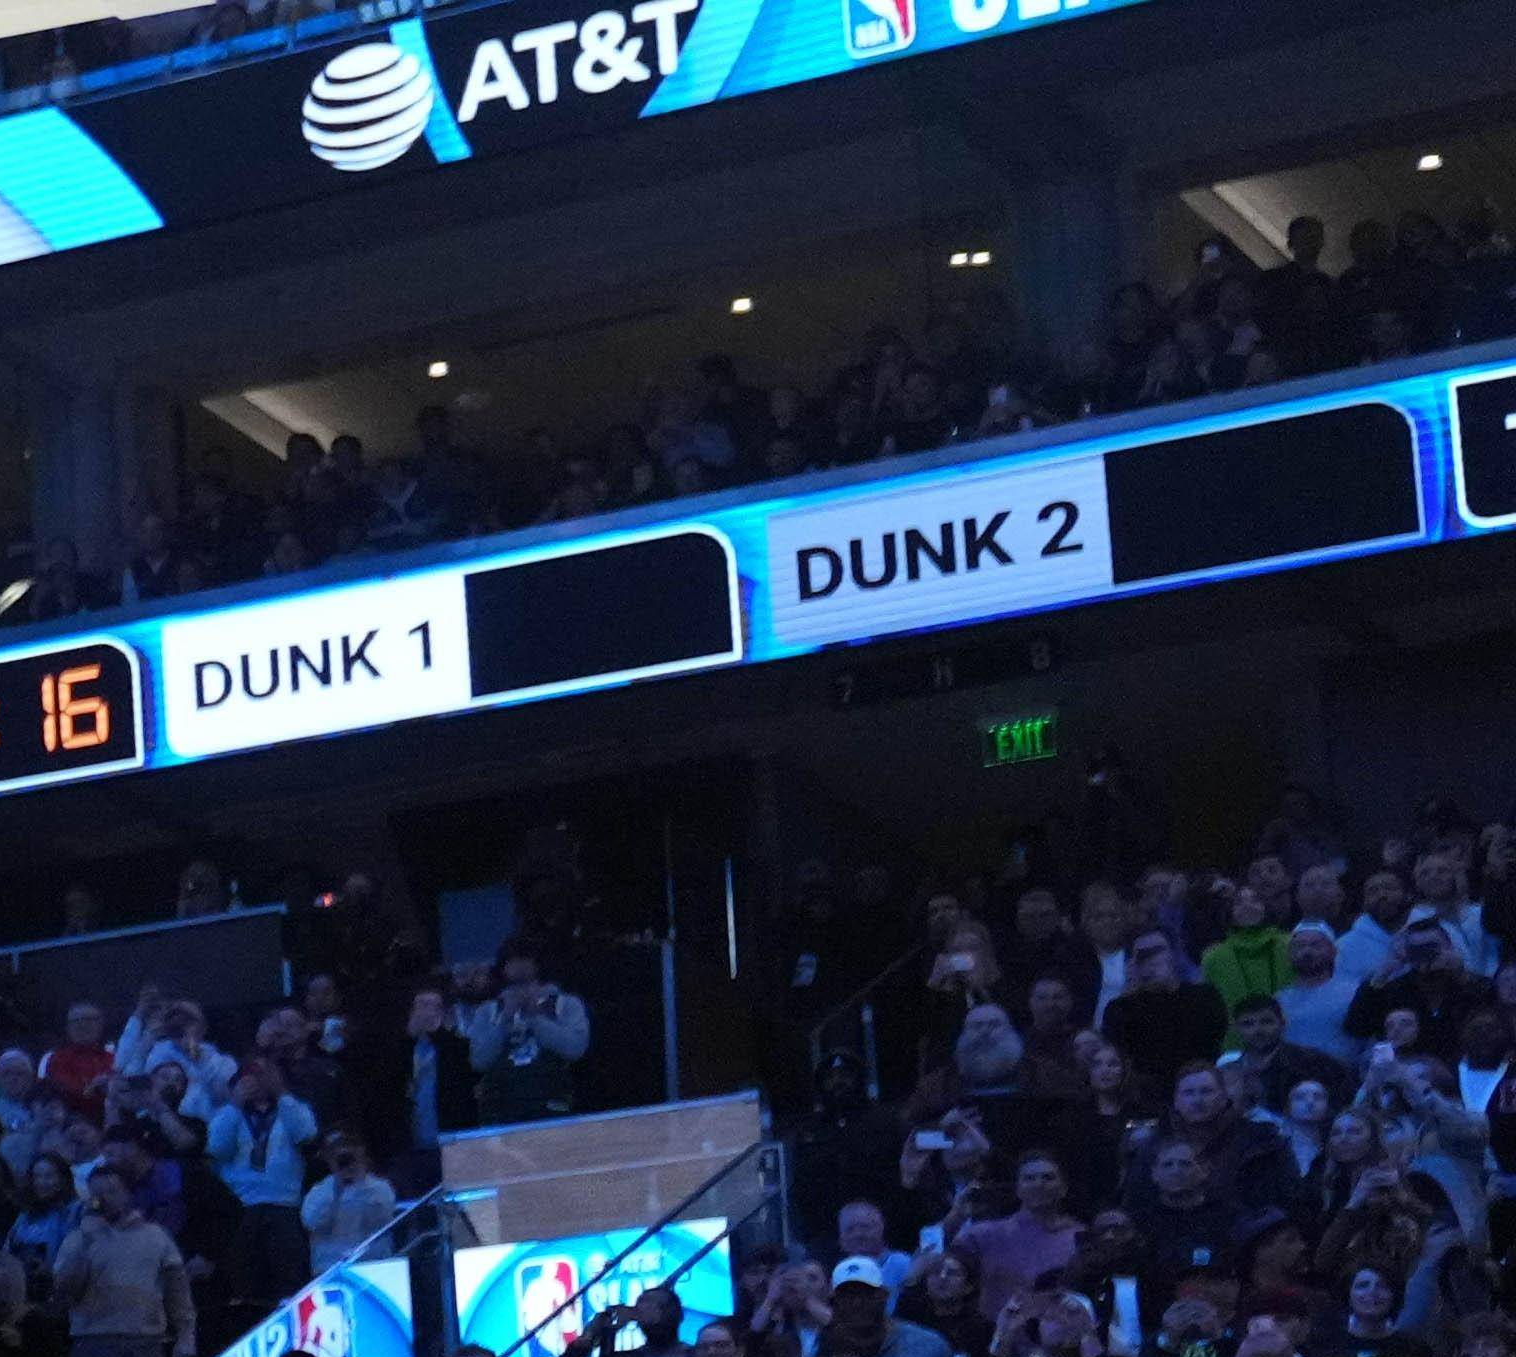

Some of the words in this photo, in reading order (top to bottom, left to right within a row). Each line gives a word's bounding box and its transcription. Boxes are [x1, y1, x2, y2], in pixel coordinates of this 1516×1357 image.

[457, 0, 698, 122] AT&T
[796, 511, 1014, 602] DUNK
[1038, 500, 1084, 560] 2
[193, 629, 383, 711] DUNK
[408, 620, 434, 671] 1
